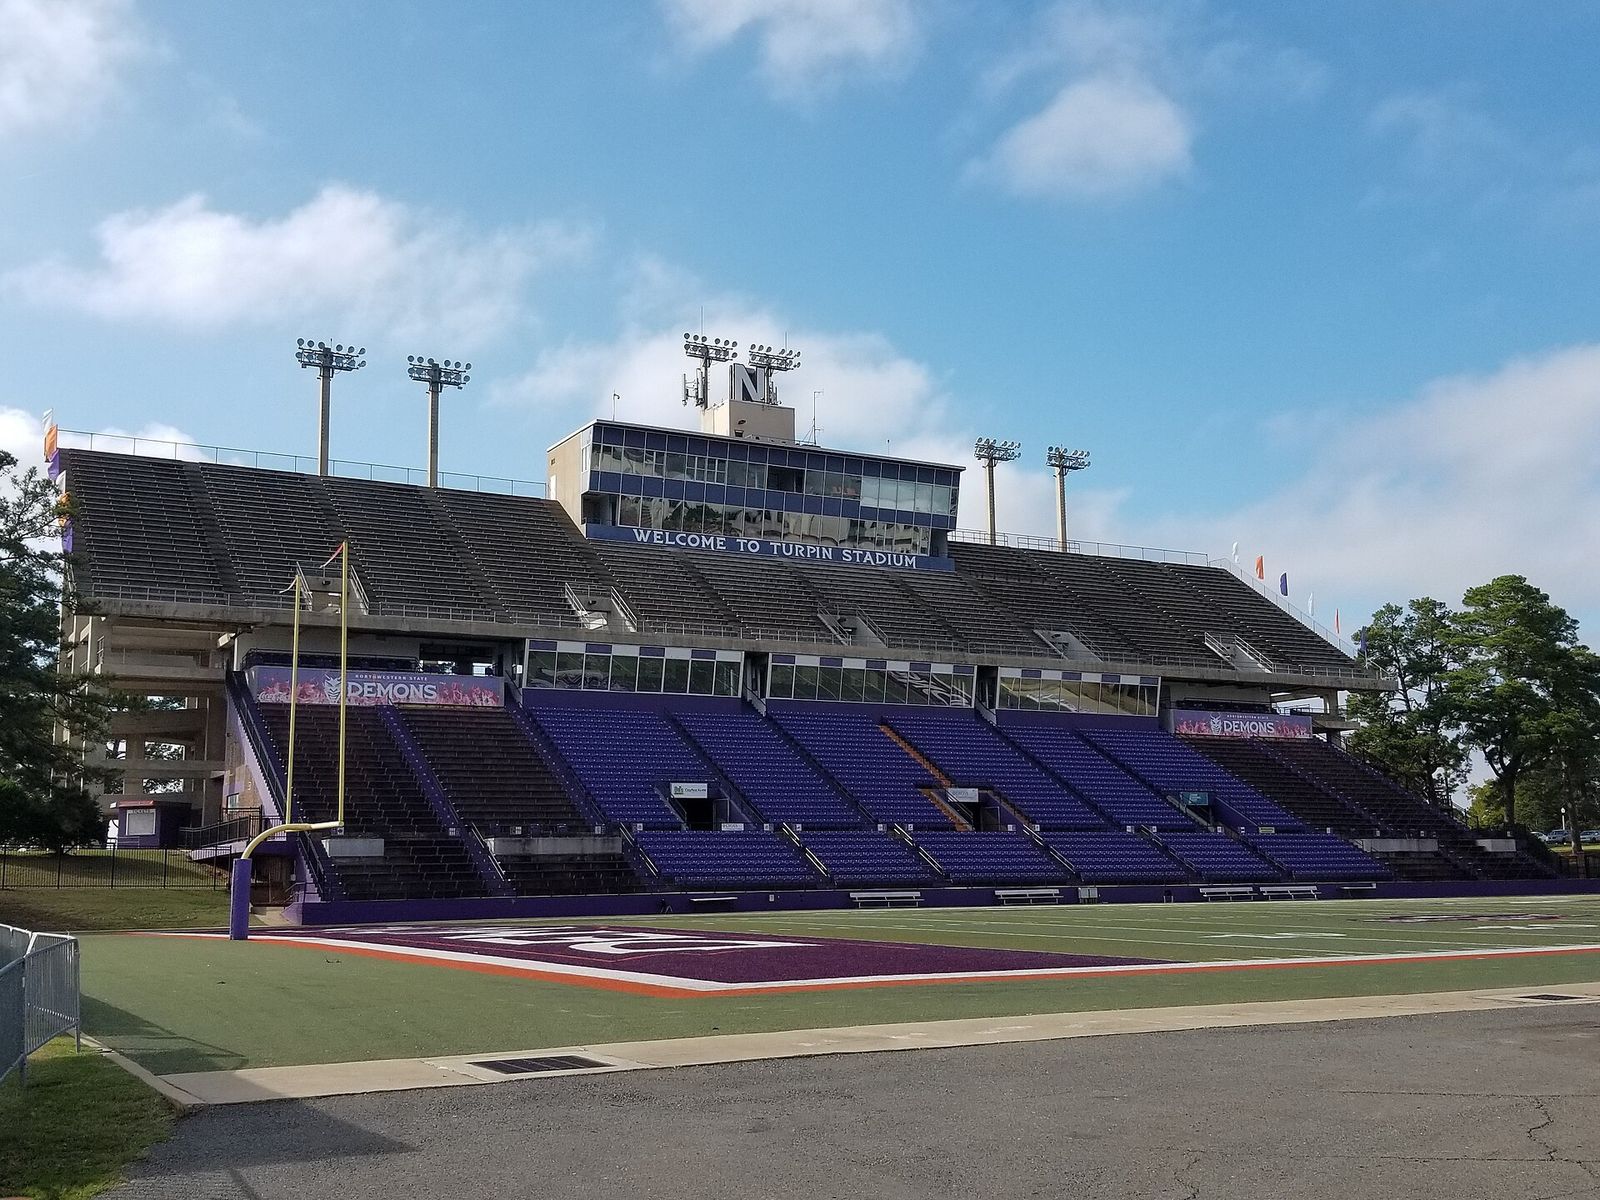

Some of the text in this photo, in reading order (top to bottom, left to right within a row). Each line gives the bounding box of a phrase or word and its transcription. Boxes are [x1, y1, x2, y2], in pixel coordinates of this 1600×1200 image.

[734, 363, 765, 402] N
[633, 529, 916, 568] WELCOME TO TURPIN STADIUM
[347, 682, 437, 701] DEMONS
[1223, 720, 1275, 734] DEMONS
